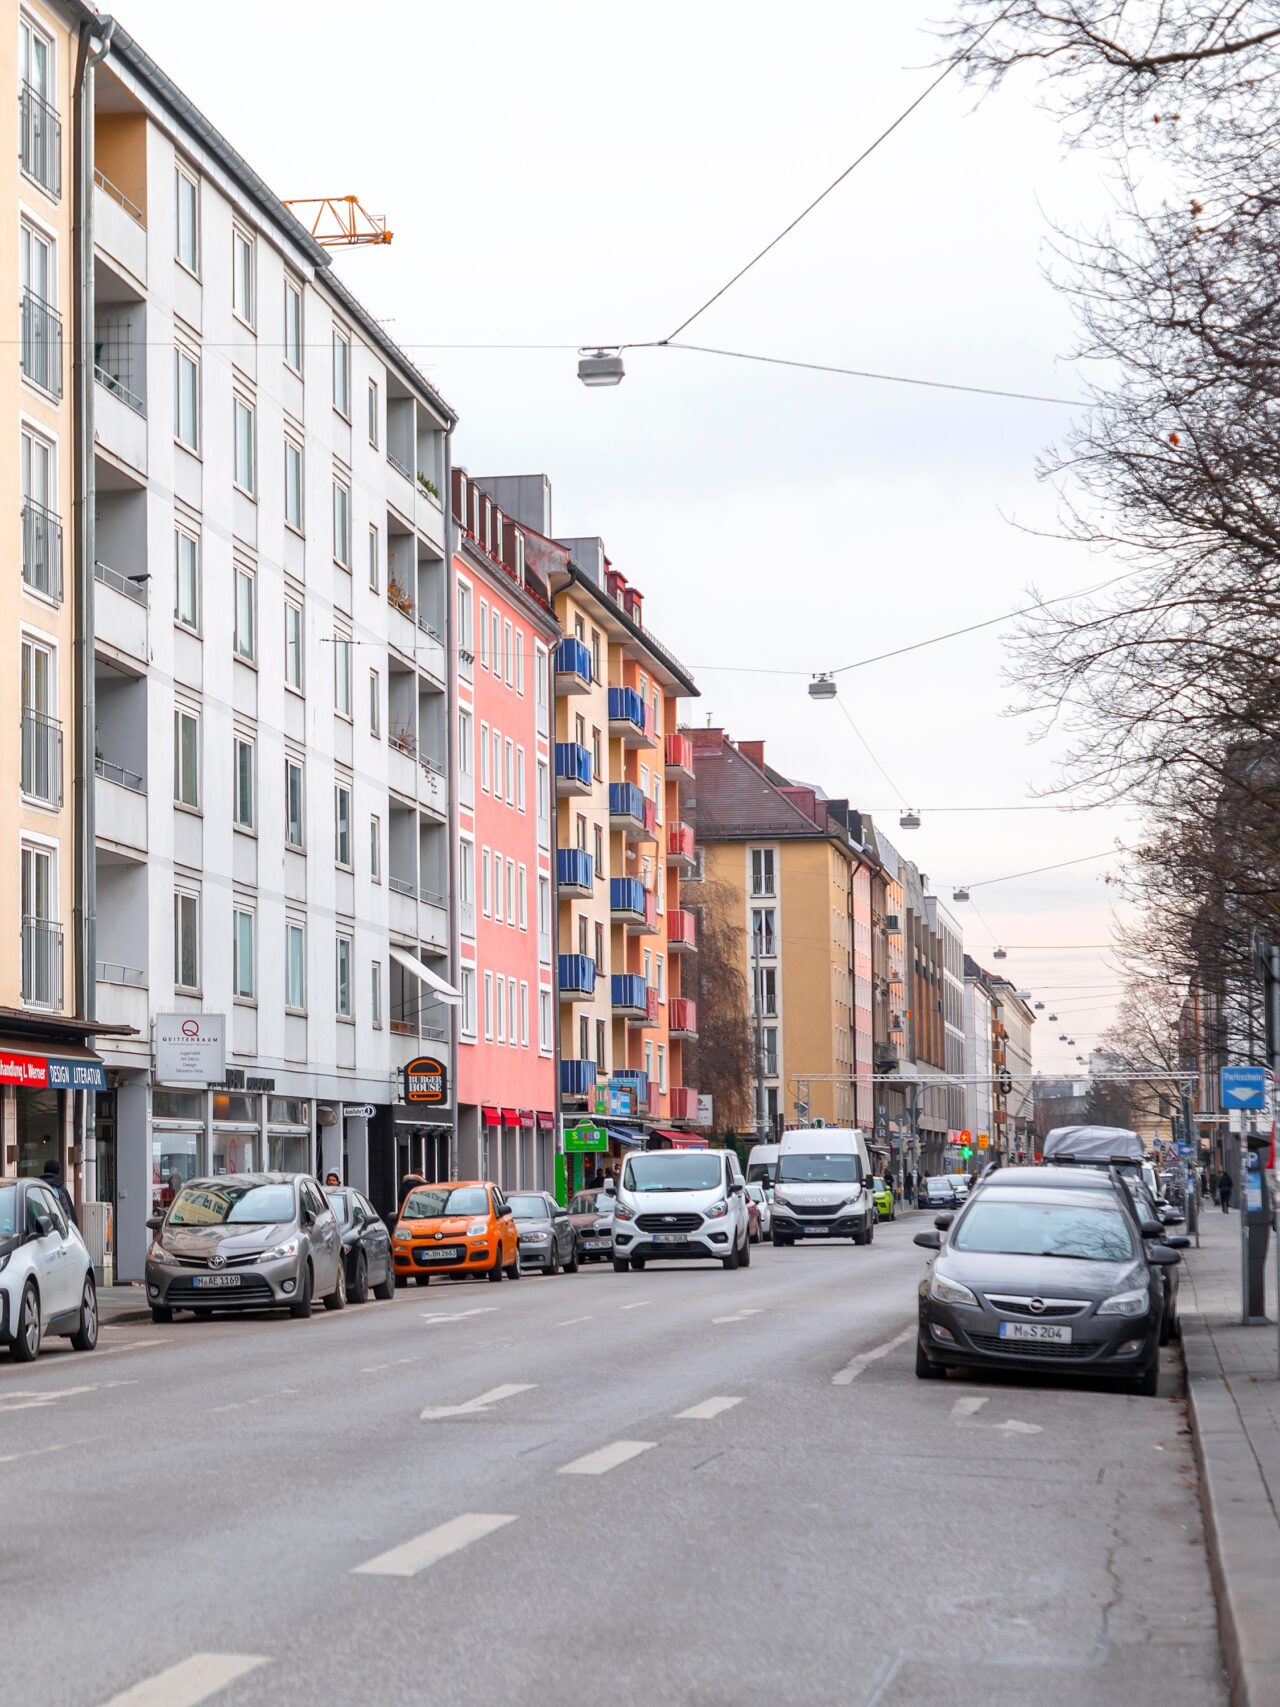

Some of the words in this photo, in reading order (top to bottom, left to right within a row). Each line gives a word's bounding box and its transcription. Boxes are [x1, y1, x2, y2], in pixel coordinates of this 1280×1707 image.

[182, 1020, 199, 1037] Q
[28, 1063, 46, 1081] Werner
[49, 1065, 70, 1083] DESIGN
[73, 1066, 101, 1085] LITERATUR
[1224, 1072, 1263, 1081] Parkschein
[409, 1075, 442, 1083] BURGER
[409, 1082, 442, 1092] HOUSE
[209, 1277, 218, 1286] AE
[220, 1276, 239, 1285] 1169
[1014, 1324, 1023, 1337] M
[1030, 1325, 1038, 1338] S
[1040, 1326, 1062, 1339] 204
